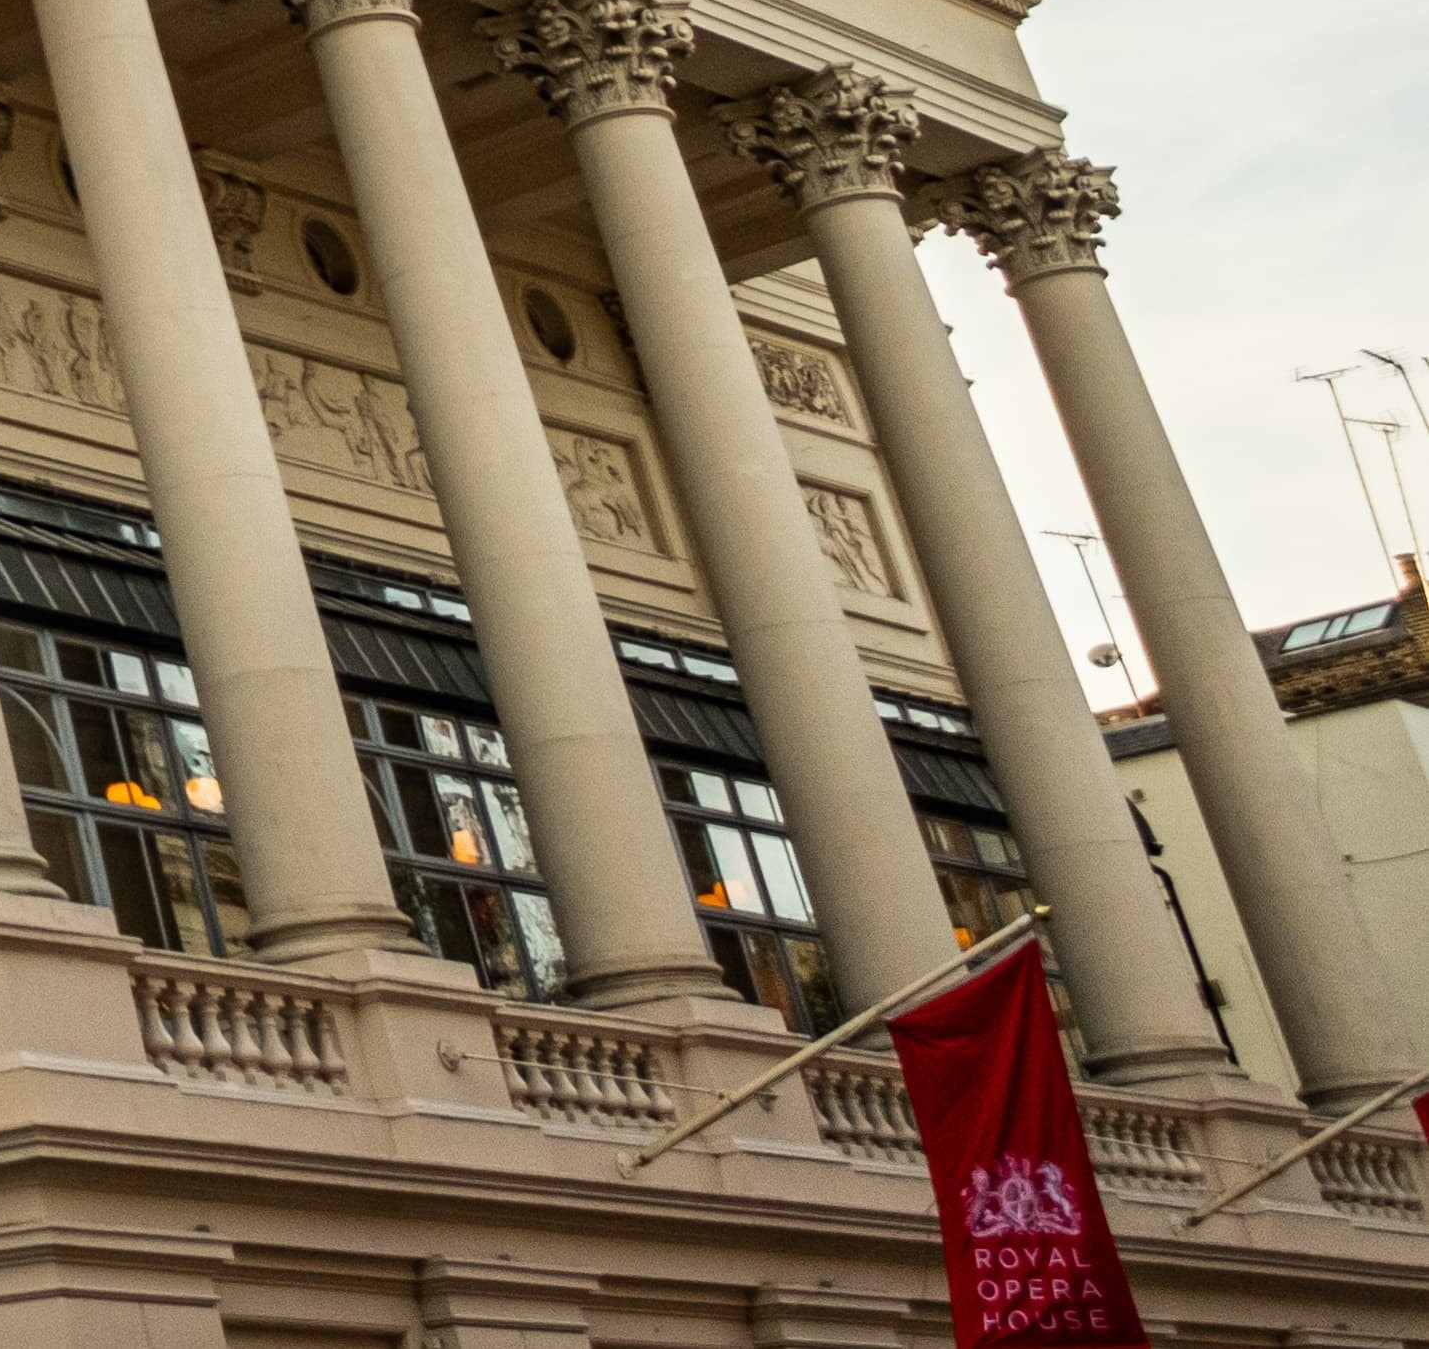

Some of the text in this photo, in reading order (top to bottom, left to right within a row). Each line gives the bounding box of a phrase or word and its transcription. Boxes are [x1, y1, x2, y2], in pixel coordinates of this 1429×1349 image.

[975, 1247, 1091, 1269] ROYAL
[977, 1279, 1102, 1301] OPERA
[983, 1309, 1108, 1331] HOUSE
